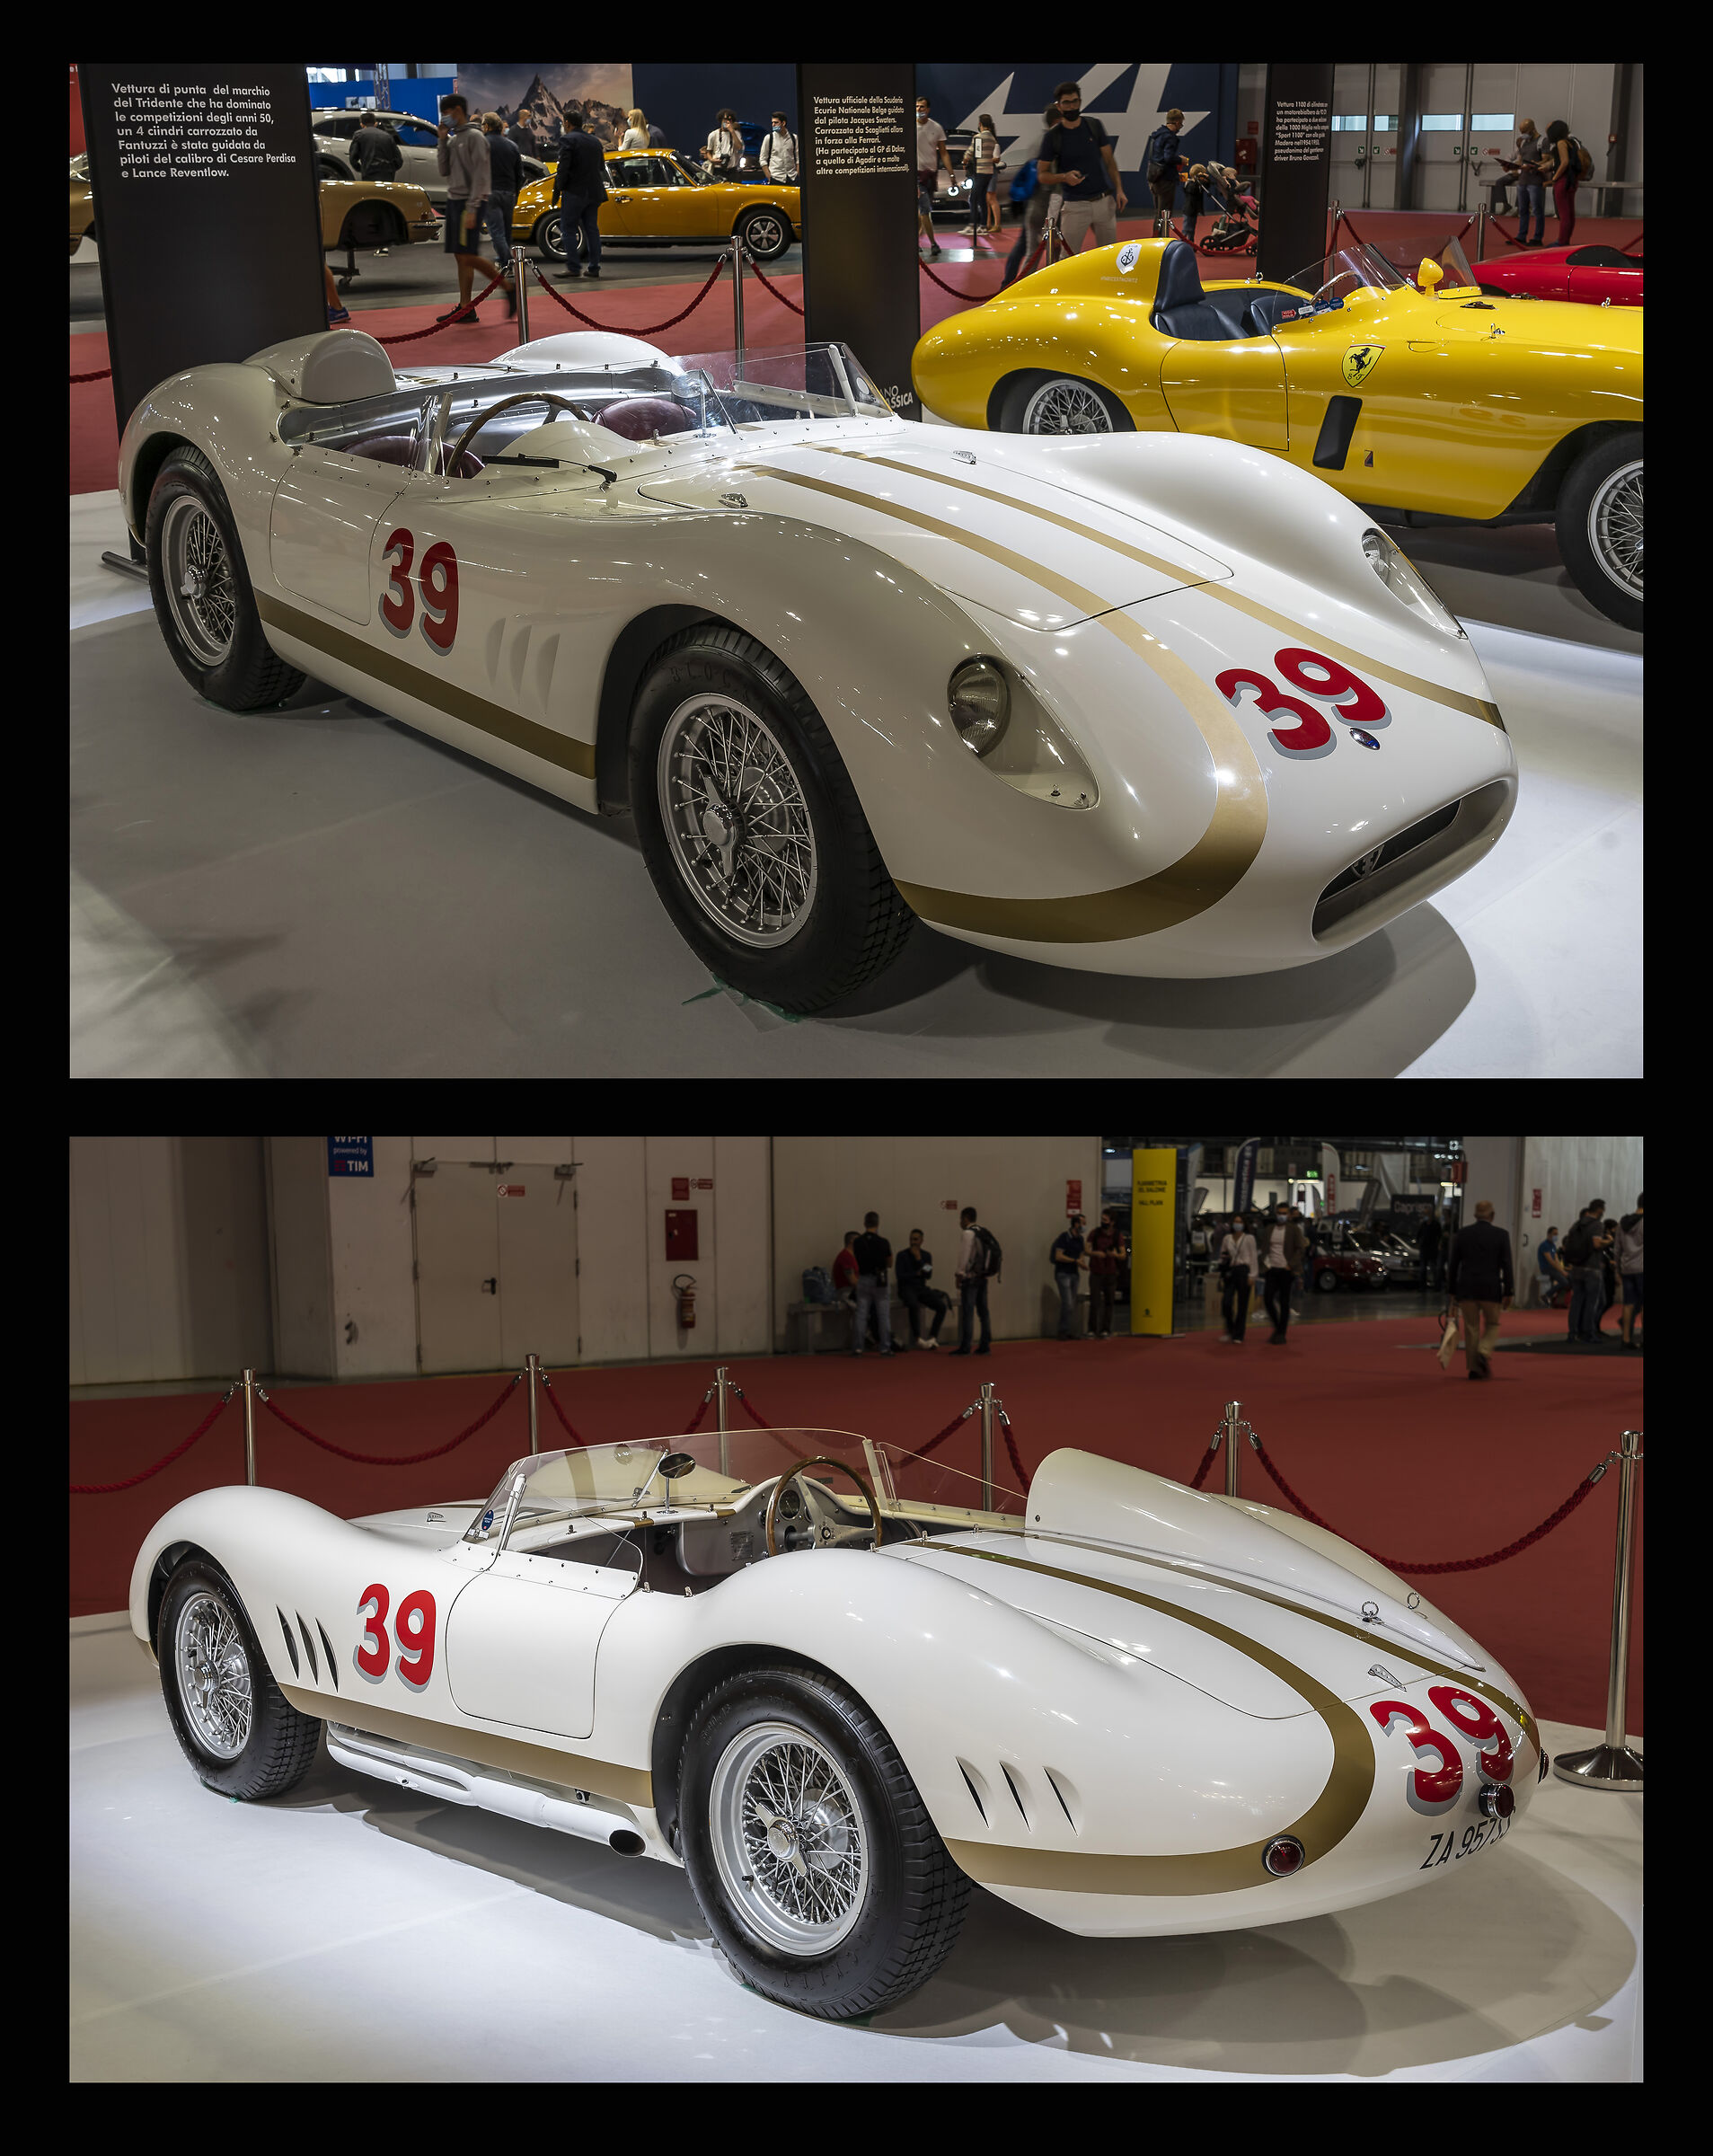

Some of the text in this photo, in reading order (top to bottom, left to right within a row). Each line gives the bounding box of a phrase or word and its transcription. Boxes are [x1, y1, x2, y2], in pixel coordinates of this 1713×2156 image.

[111, 84, 269, 96] Vettura di punta del marchio
[114, 97, 270, 109] del Tridente che ha dominato
[815, 106, 836, 114] Ecurie
[872, 106, 887, 115] Belge
[115, 111, 273, 124] le competizioni degli anni 50,
[828, 117, 848, 126] pilota
[850, 117, 875, 125] Jacques
[137, 126, 144, 136] 4
[148, 126, 183, 136] ciindri
[188, 128, 243, 136] carrozzato
[245, 126, 257, 136] da
[855, 126, 863, 134] da
[119, 139, 265, 152] Fantuzzi è stata guidata da
[859, 136, 880, 144] Ferrari.
[816, 147, 829, 156] (Ha
[831, 146, 869, 156] partecipato
[120, 153, 296, 166] piloti del calibro di Cesare Perdisa
[823, 156, 845, 166] quello
[855, 155, 877, 166] Agadir
[133, 168, 166, 177] Lance
[171, 167, 229, 177] Reventlow.
[834, 165, 876, 175] competizioni
[378, 527, 459, 657] 39
[1214, 647, 1391, 760] 39
[347, 1160, 368, 1171] TIM
[352, 1583, 437, 1694] 39
[1369, 1685, 1514, 1816] 39
[1419, 1831, 1455, 1870] ZA
